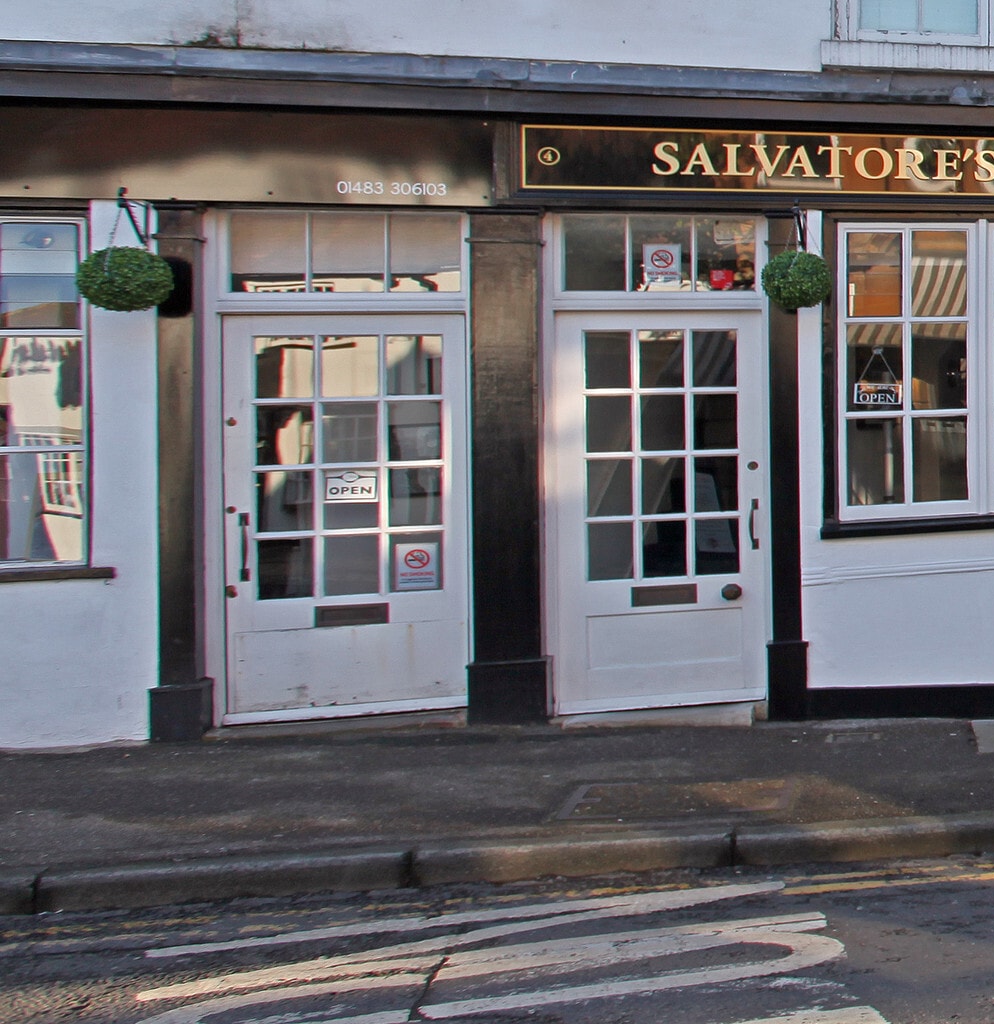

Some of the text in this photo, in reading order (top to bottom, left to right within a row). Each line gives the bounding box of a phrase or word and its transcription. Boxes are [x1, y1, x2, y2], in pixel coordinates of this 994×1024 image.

[336, 180, 447, 196] 01483 306103
[859, 393, 896, 403] OPEN
[329, 486, 372, 495] OPEN
